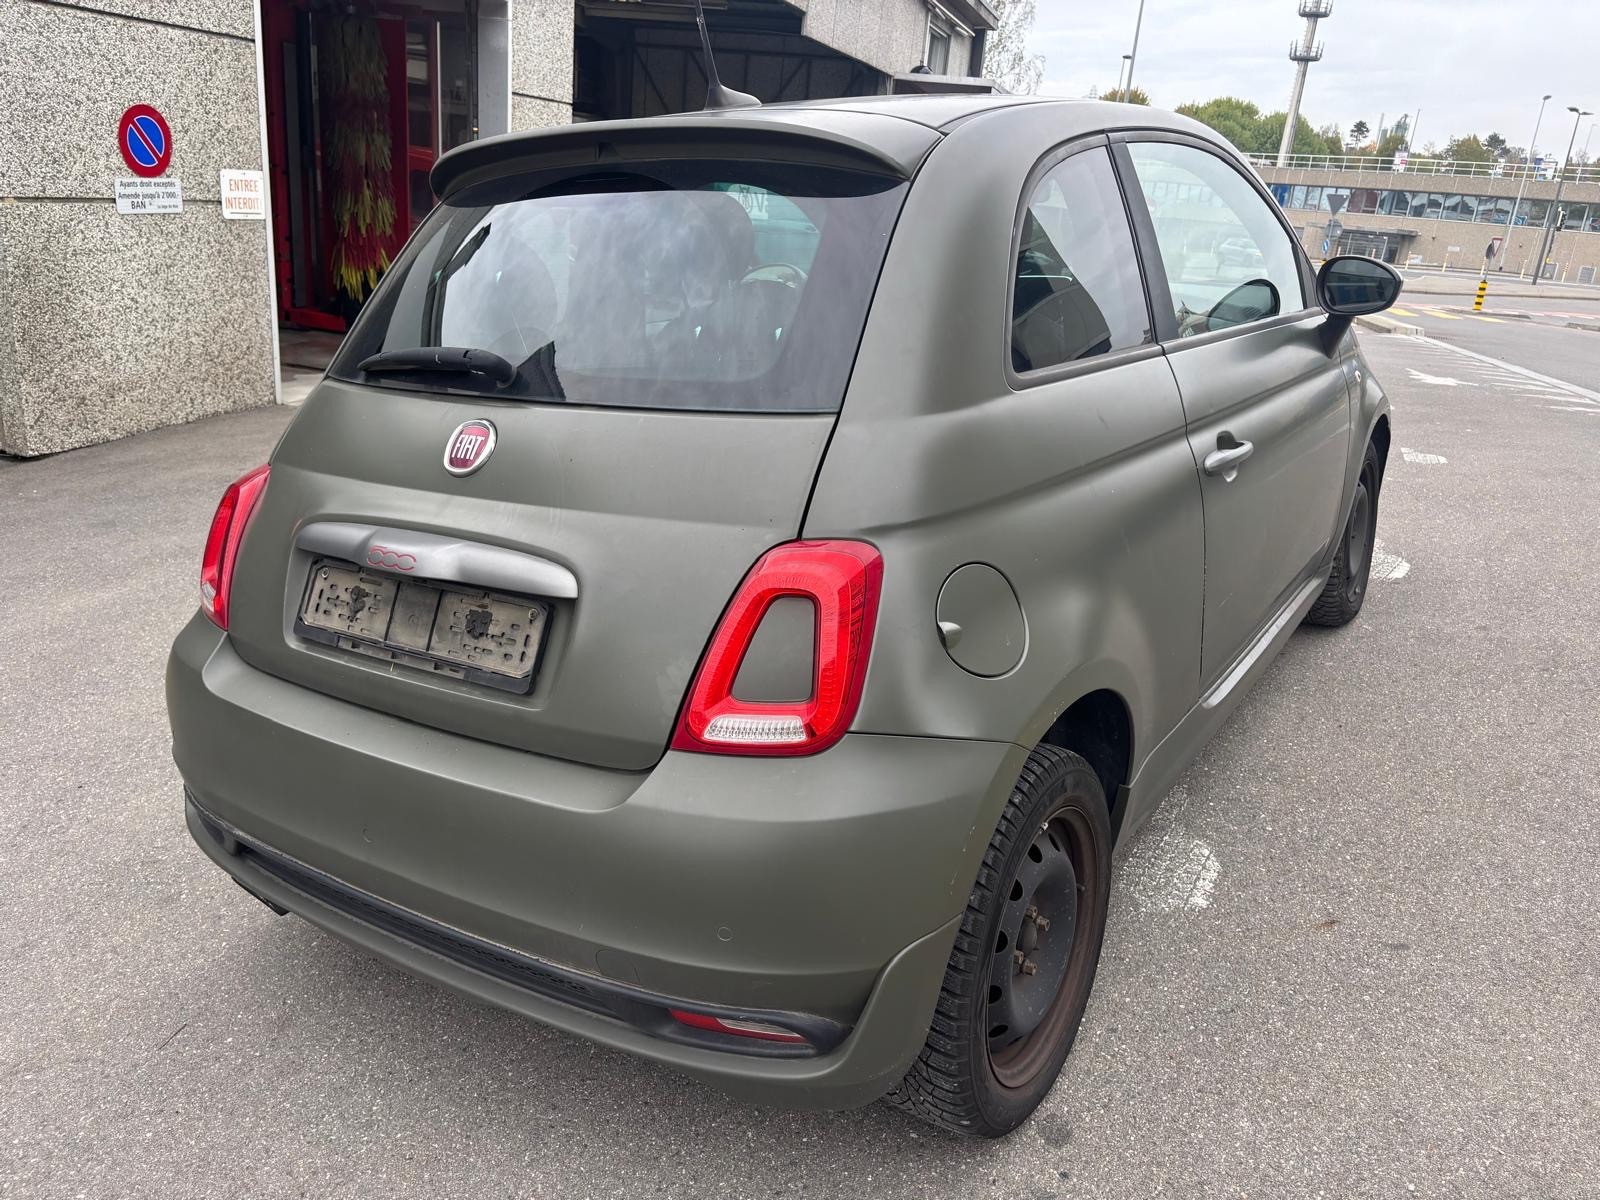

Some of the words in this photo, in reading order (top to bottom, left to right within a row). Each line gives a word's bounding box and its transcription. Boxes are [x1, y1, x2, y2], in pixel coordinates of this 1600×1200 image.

[120, 180, 138, 189] Ayants
[139, 180, 152, 188] droit
[131, 201, 146, 209] BAN
[451, 434, 485, 460] FIAT
